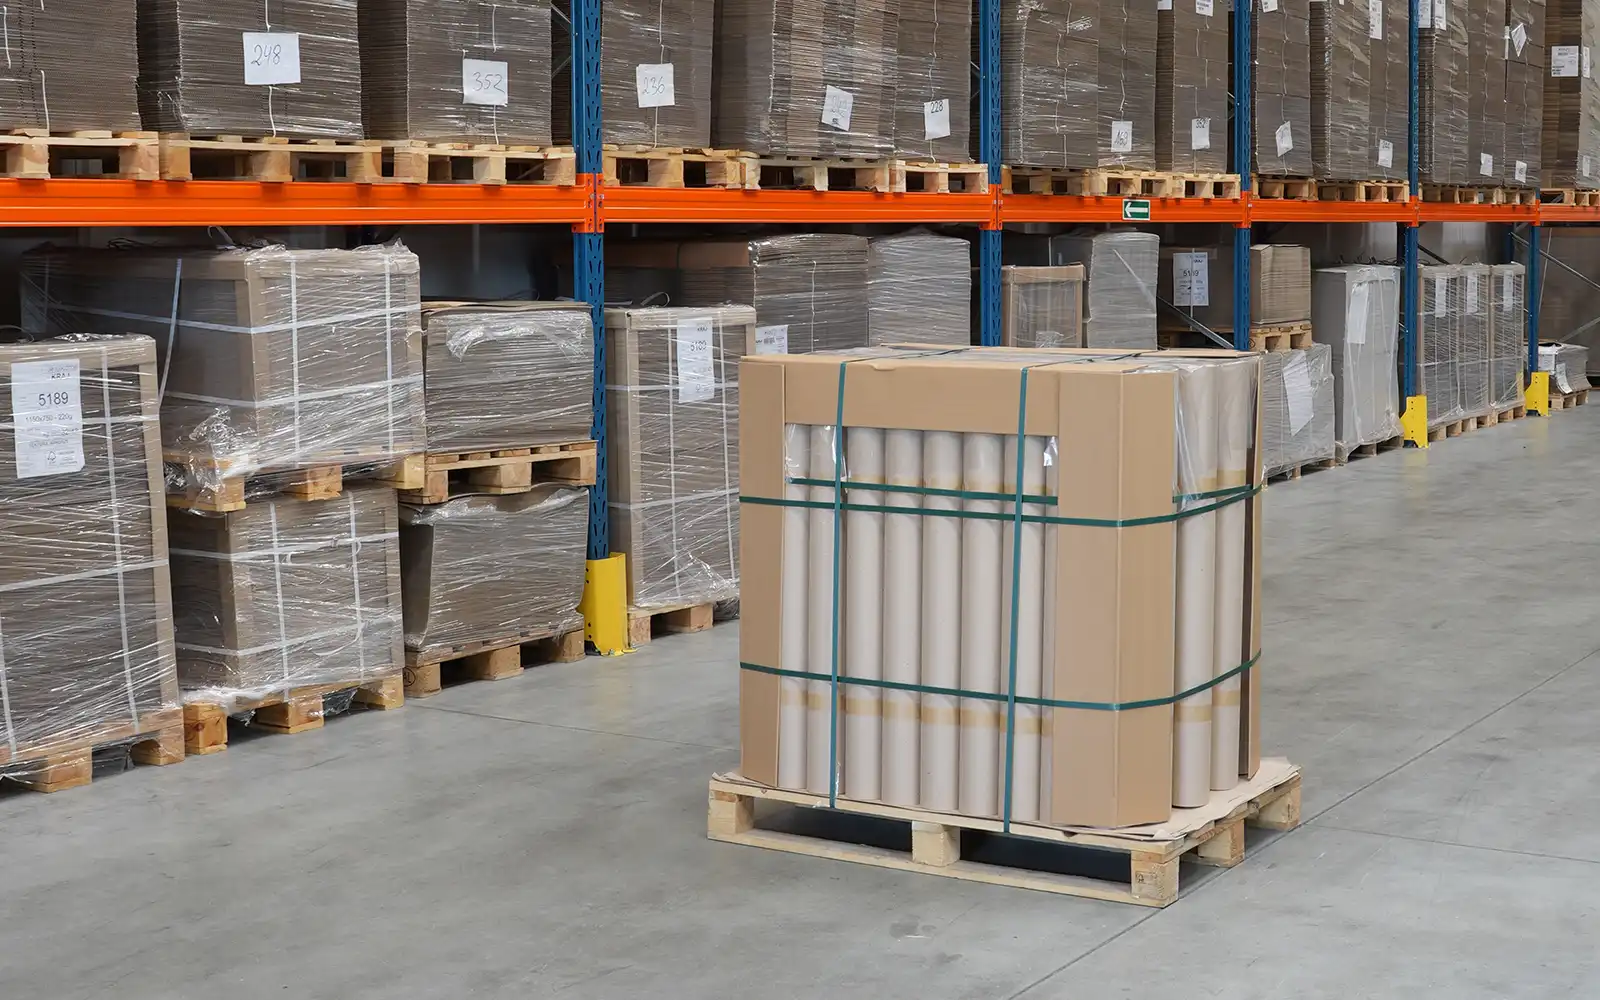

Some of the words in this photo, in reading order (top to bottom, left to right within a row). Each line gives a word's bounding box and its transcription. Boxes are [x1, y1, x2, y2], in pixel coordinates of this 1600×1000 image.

[251, 44, 282, 66] 248
[472, 71, 506, 94] 352
[642, 75, 666, 96] 236
[38, 391, 69, 407] 5189
